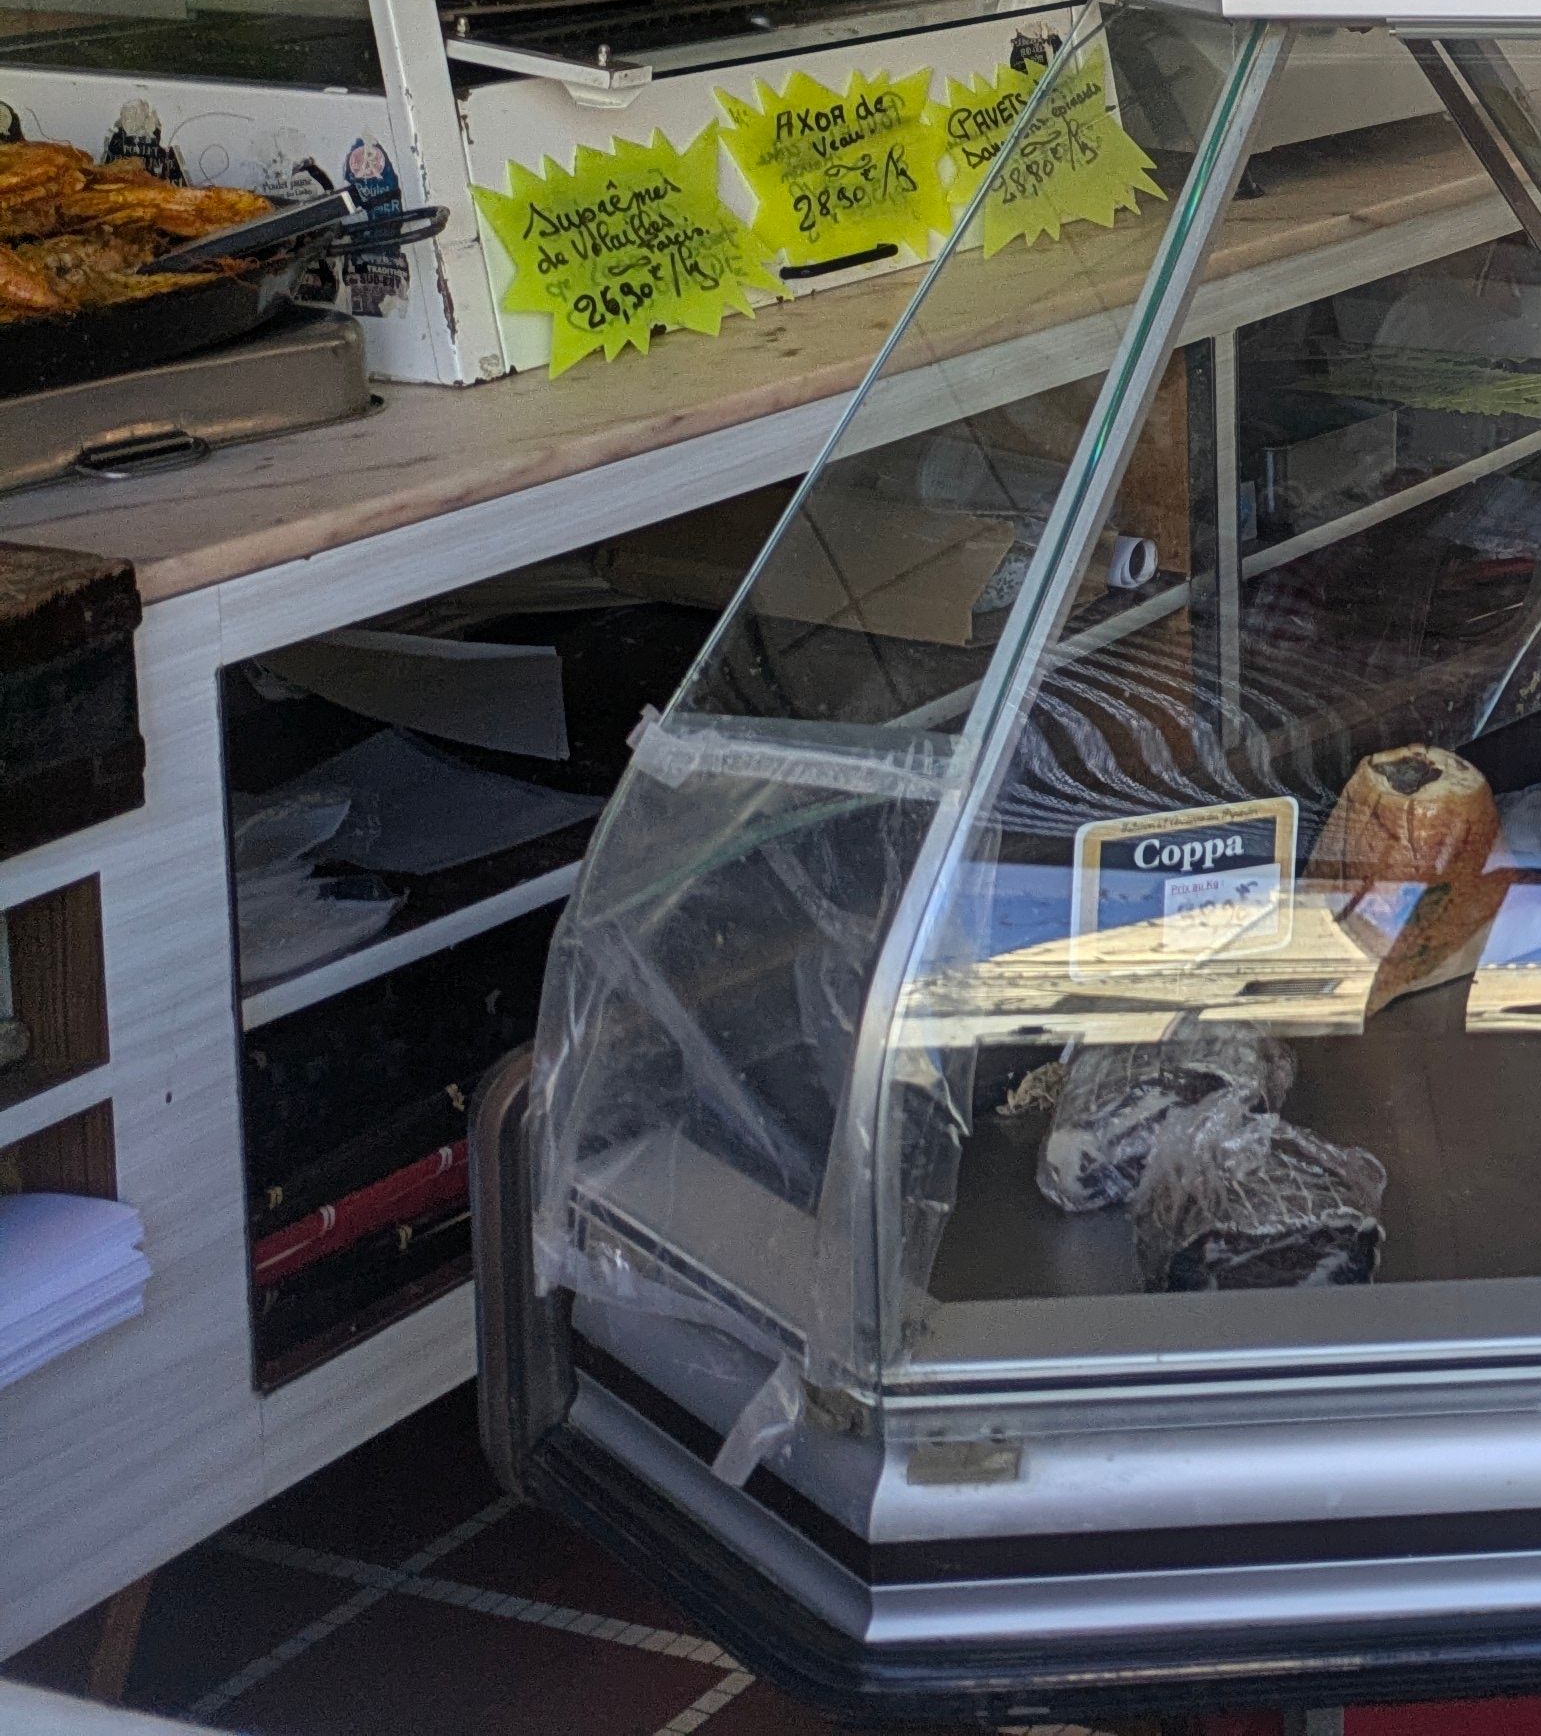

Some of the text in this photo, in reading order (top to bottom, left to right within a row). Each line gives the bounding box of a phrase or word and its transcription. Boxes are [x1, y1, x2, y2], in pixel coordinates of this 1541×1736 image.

[855, 93, 888, 122] de
[537, 244, 570, 275] de
[1133, 834, 1245, 873] Coppa
[1171, 884, 1190, 896] Prix
[1191, 883, 1205, 895] au
